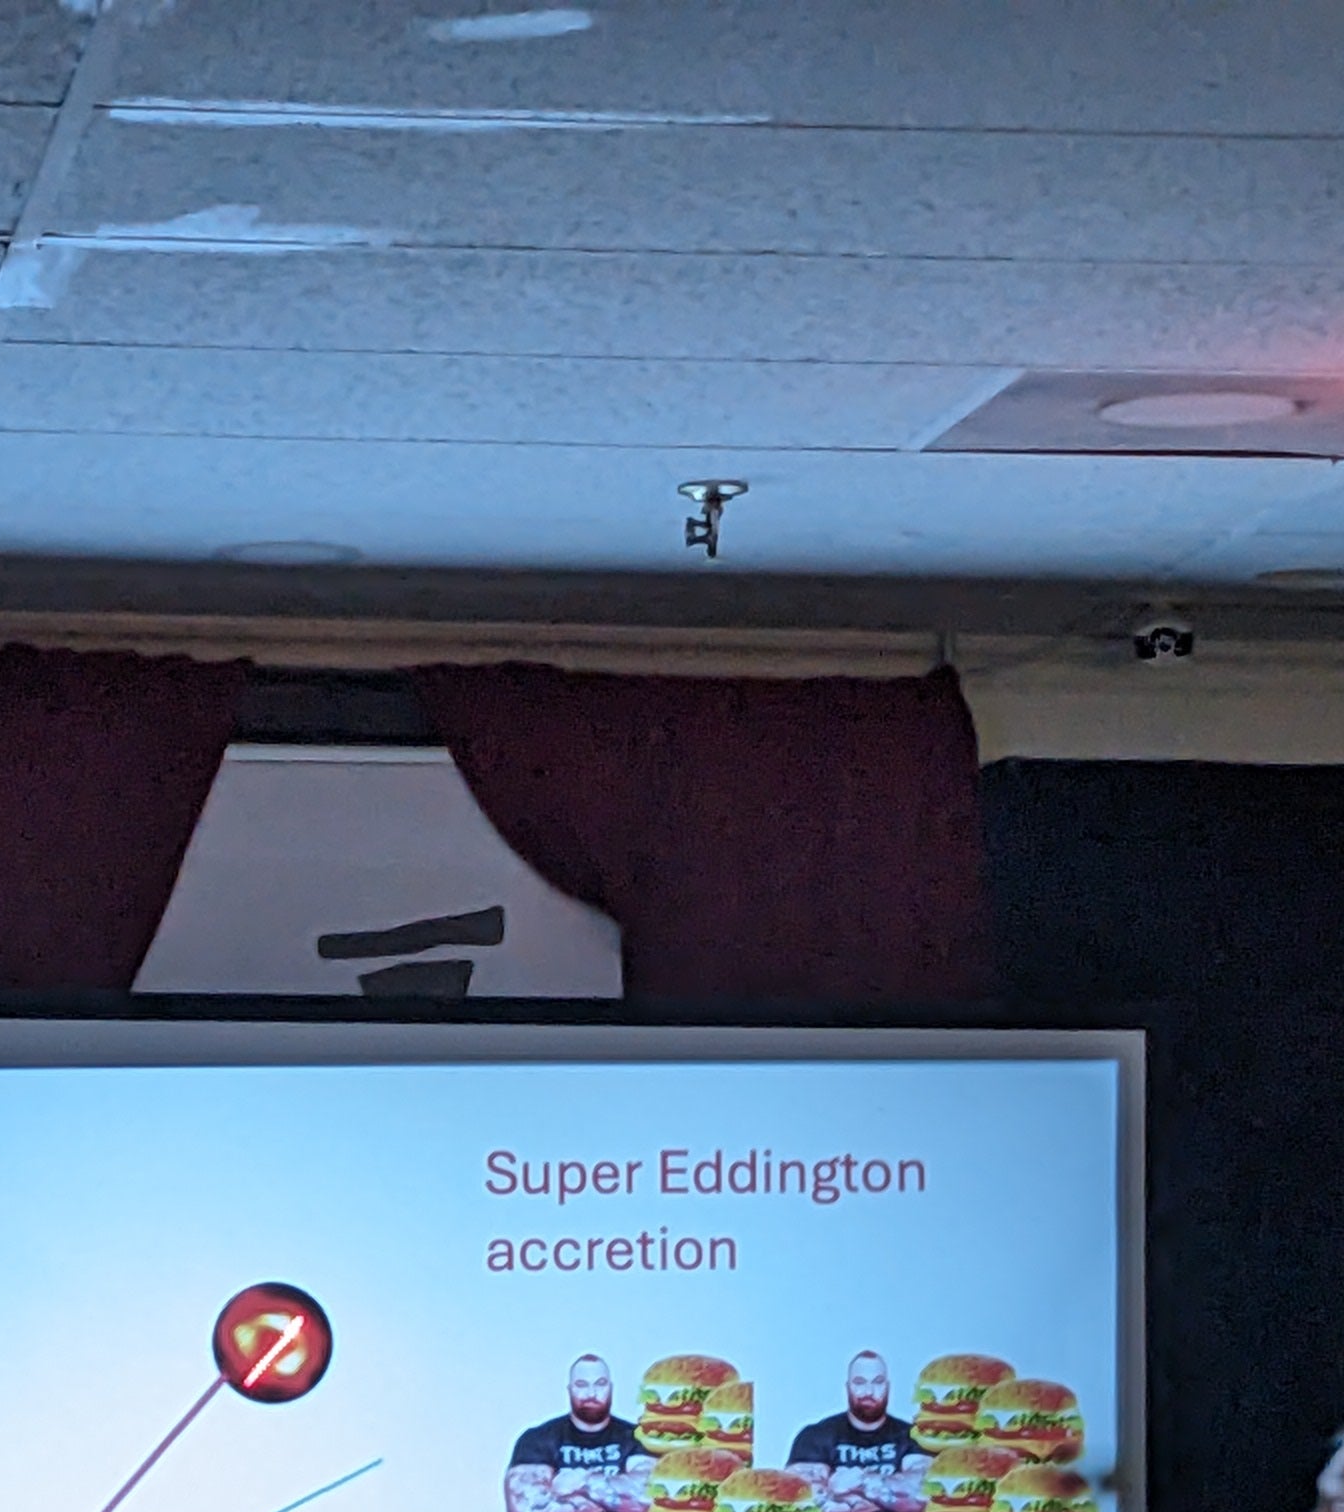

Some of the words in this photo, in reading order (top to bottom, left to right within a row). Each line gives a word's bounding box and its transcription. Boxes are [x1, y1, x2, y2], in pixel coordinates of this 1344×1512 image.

[484, 1149, 643, 1206] Super
[659, 1148, 927, 1205] Eddington
[485, 1225, 738, 1272] accretion
